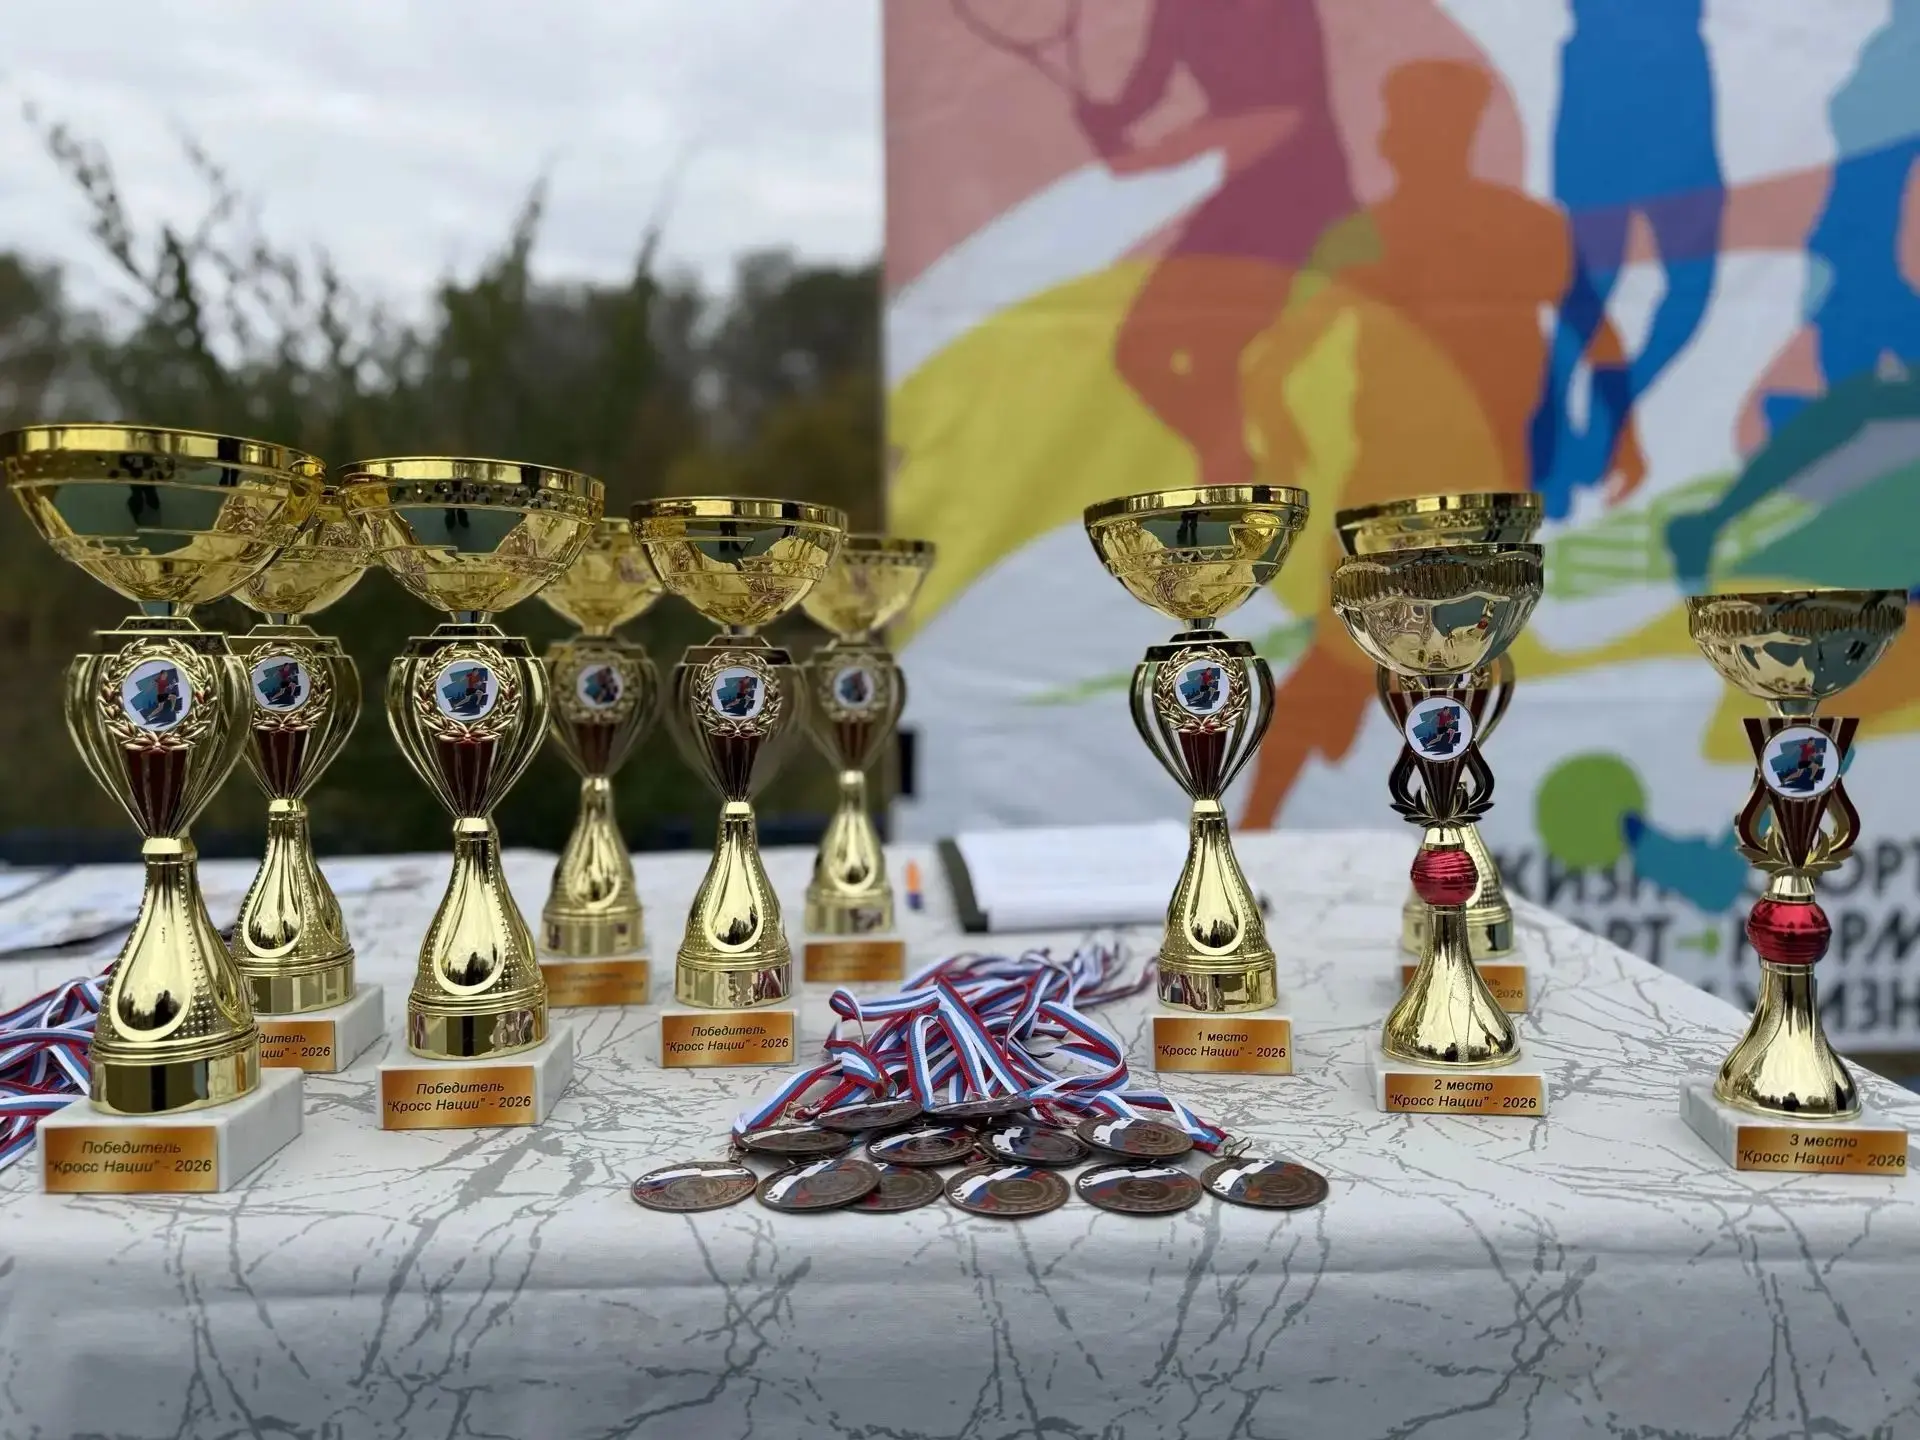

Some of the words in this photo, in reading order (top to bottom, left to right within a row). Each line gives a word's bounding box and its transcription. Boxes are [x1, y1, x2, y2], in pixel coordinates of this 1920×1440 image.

[691, 1025, 767, 1037] Победитель
[1197, 1031, 1203, 1040] 1
[1207, 1033, 1248, 1042] место
[259, 1033, 306, 1044] дитель
[761, 1038, 789, 1049] 2026
[301, 1046, 331, 1057] 2026
[1256, 1047, 1286, 1058] 2026
[416, 1082, 505, 1095] Победитель
[1434, 1079, 1442, 1090] 2
[1446, 1081, 1493, 1091] место
[499, 1095, 531, 1108] 2026
[1502, 1097, 1537, 1109] 2026
[1790, 1133, 1799, 1146] 3
[1804, 1137, 1858, 1148] место
[82, 1141, 182, 1155] Победитель
[174, 1159, 212, 1173] 2026
[1867, 1154, 1906, 1167] 2026
